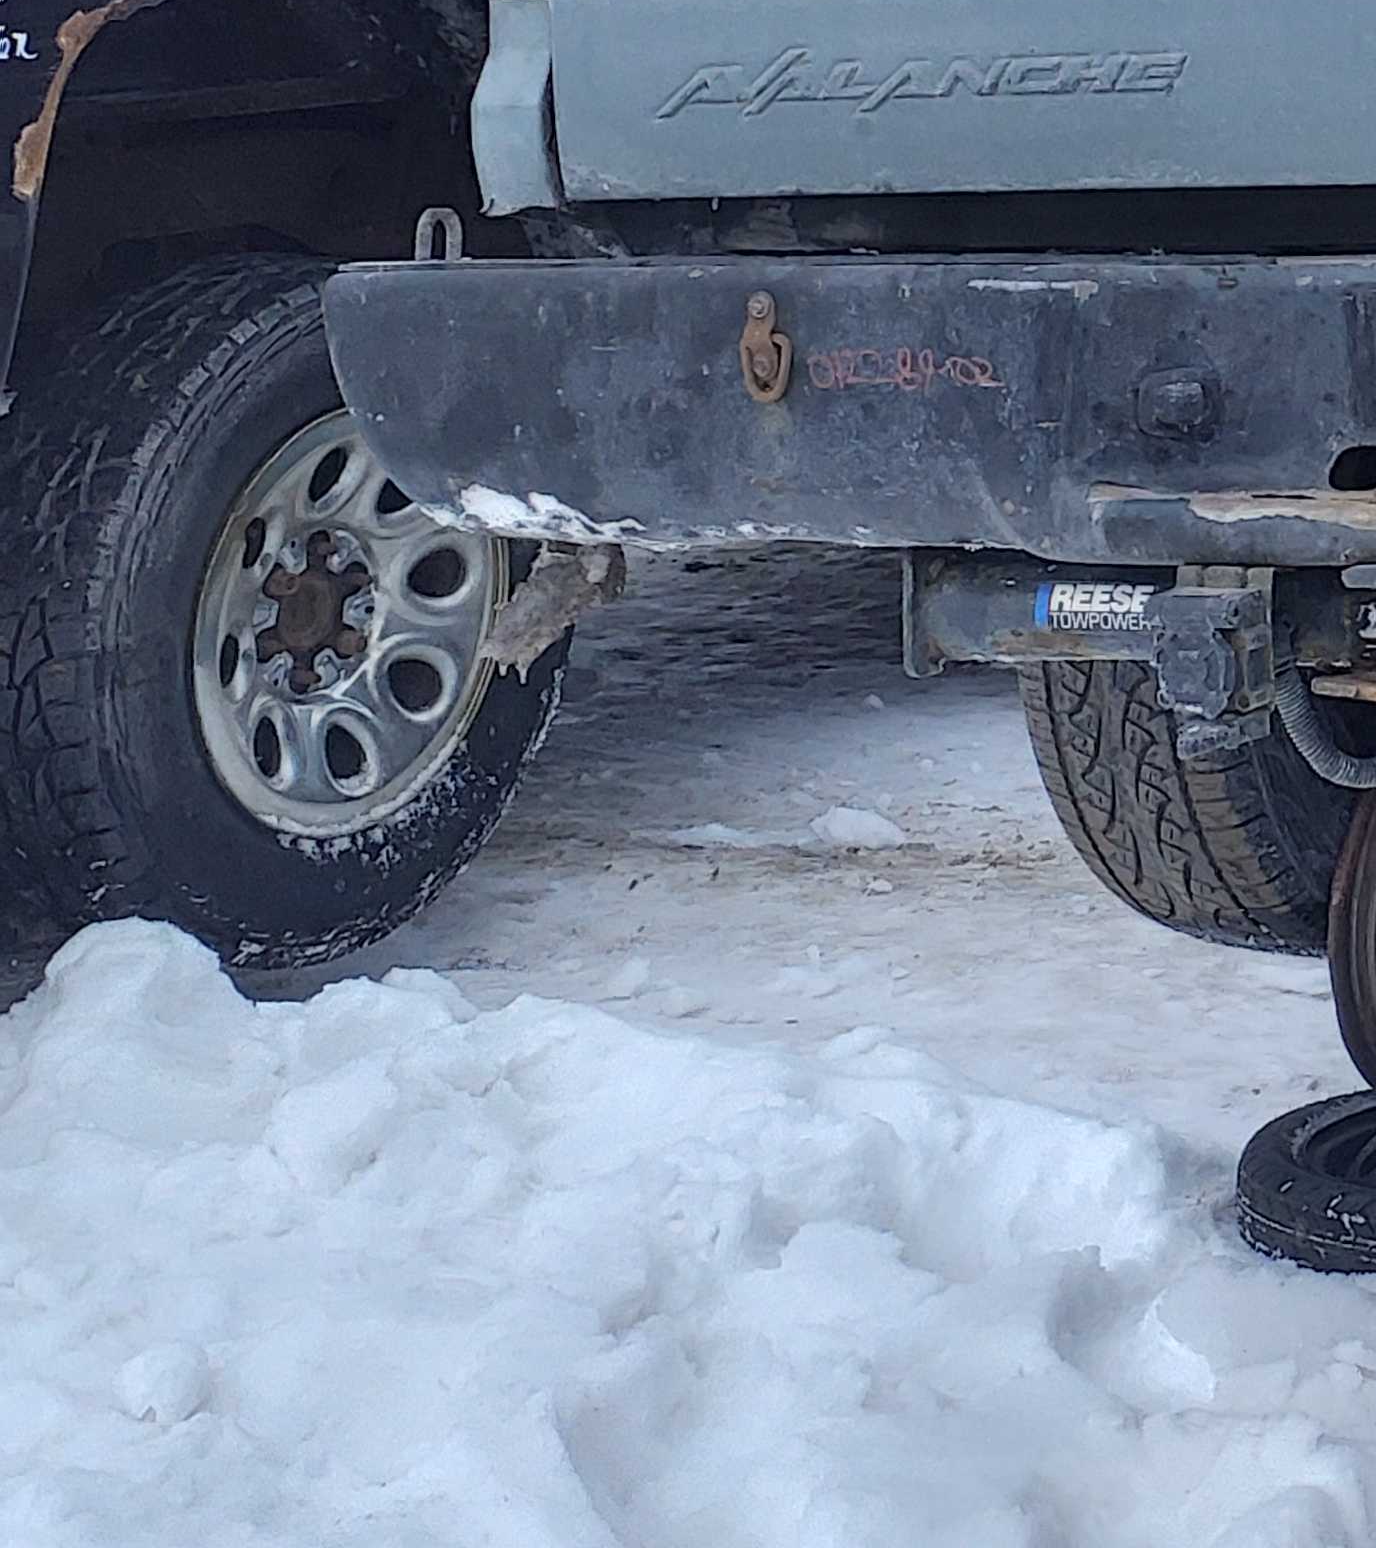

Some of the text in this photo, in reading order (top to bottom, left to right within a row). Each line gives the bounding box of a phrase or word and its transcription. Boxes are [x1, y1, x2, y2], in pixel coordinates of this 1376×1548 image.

[657, 47, 1188, 118] AVALANCHE
[1050, 583, 1154, 613] REESE
[1050, 612, 1152, 630] TOWPOWER
